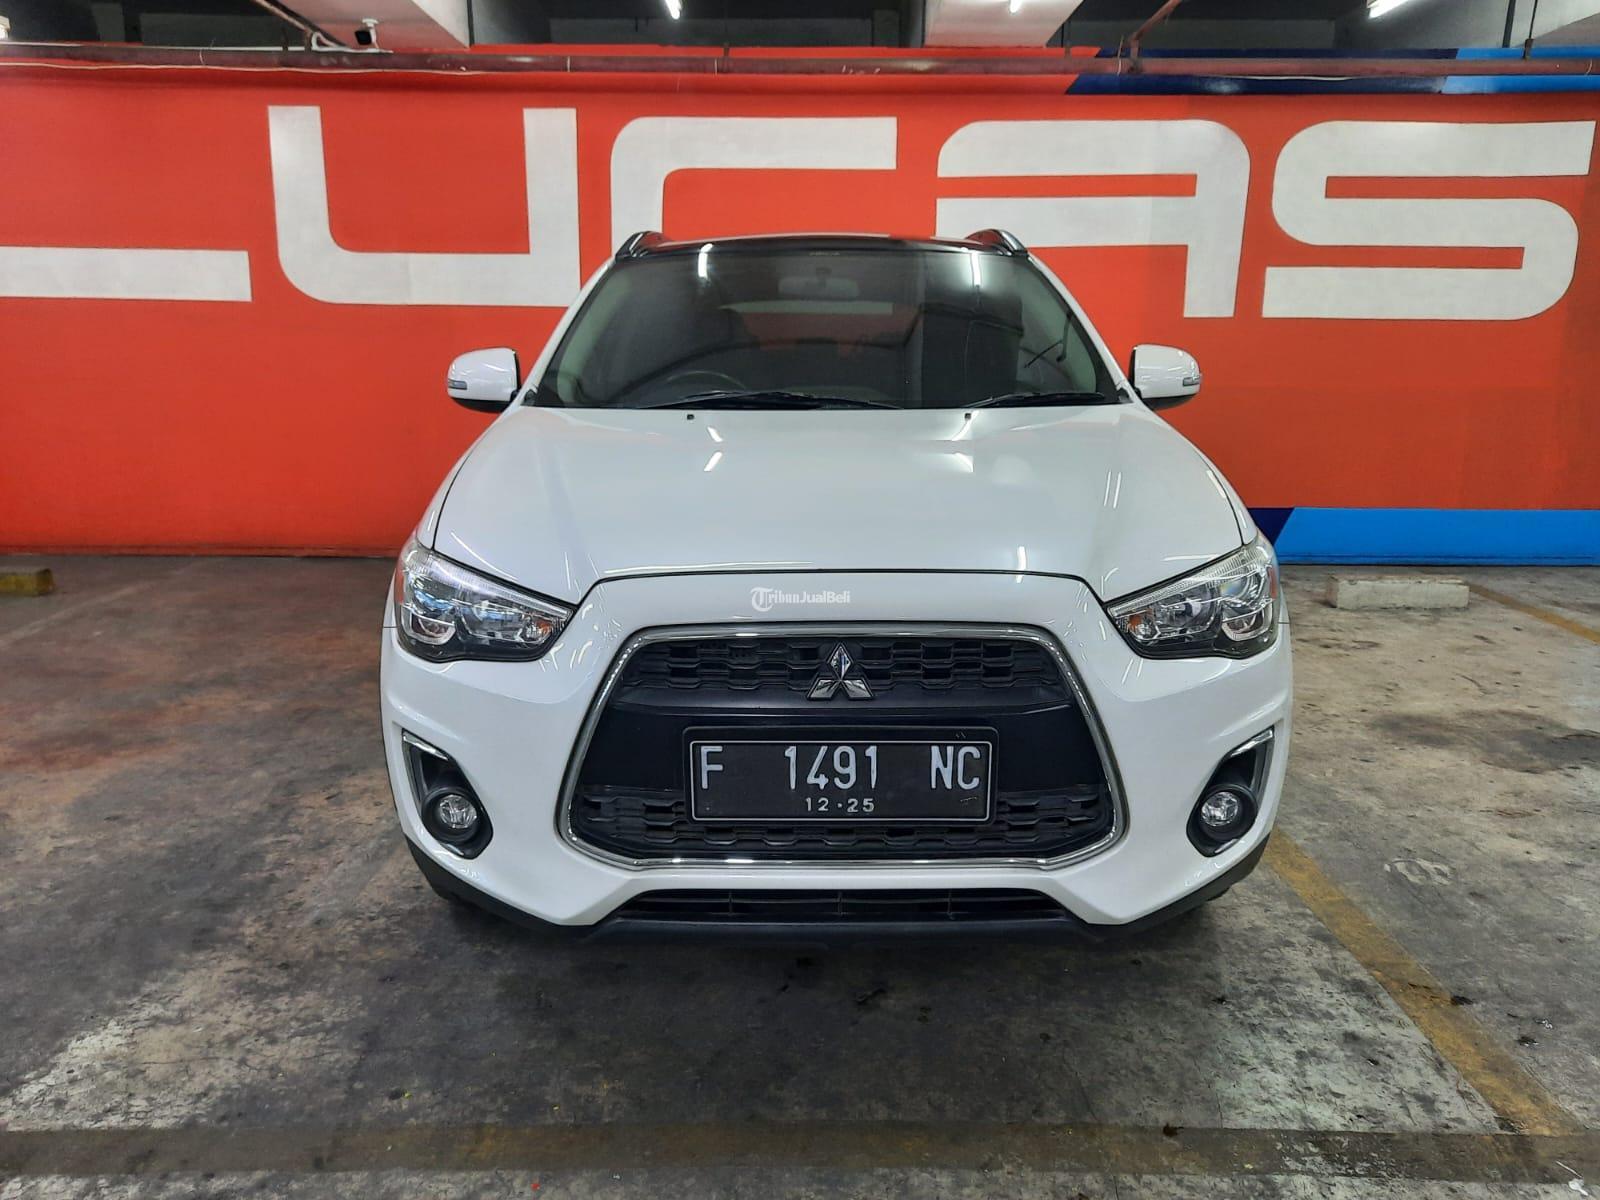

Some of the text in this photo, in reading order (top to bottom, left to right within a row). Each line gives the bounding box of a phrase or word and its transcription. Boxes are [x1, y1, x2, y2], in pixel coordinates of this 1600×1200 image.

[701, 746, 981, 789] F 1491 NC
